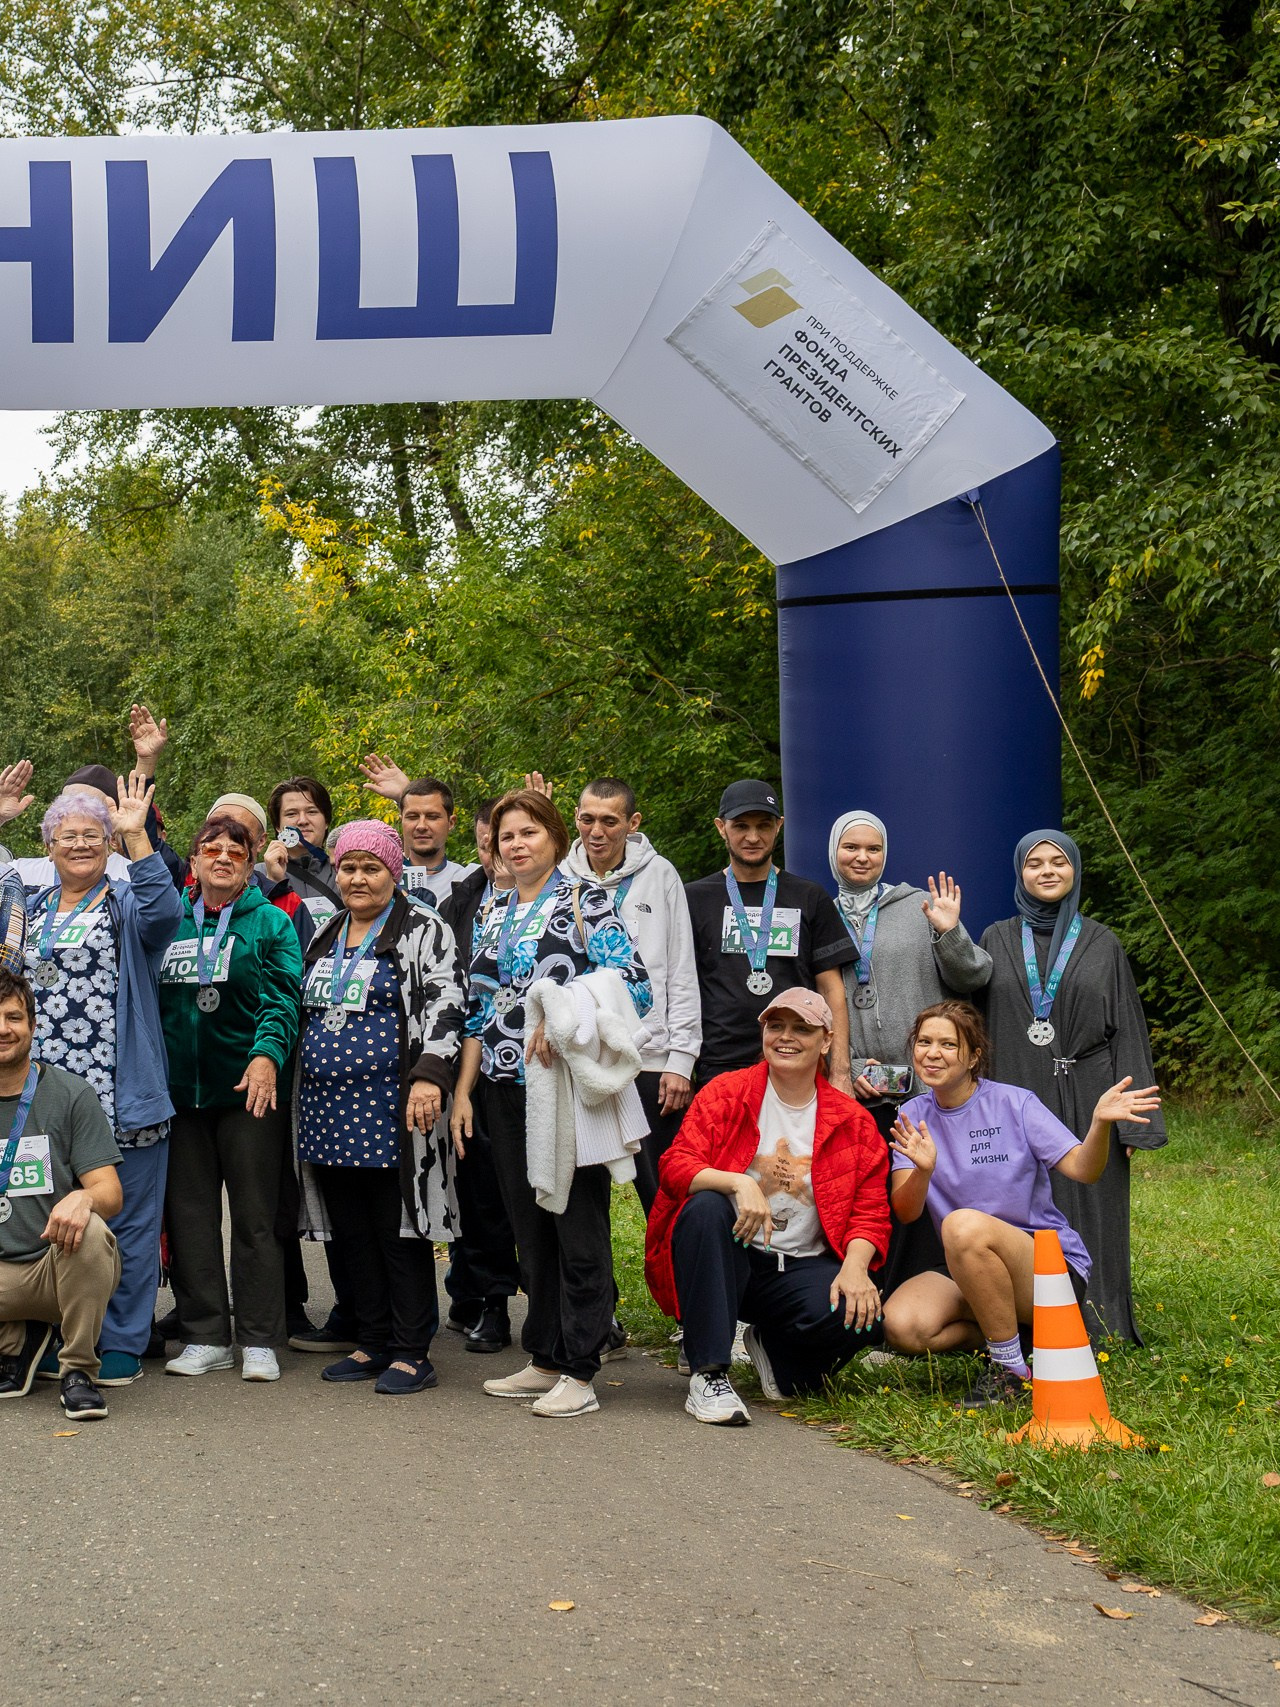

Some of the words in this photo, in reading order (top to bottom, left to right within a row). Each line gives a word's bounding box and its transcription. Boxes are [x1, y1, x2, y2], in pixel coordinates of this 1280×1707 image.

[763, 359, 833, 424] ГРАНТОВ
[794, 329, 849, 382] ФОНДА
[805, 315, 831, 340] ПРИ
[829, 335, 898, 400] ПОДДЕРЖКЕ
[778, 343, 903, 459] ПРЕЗИДЕНТСКИХ
